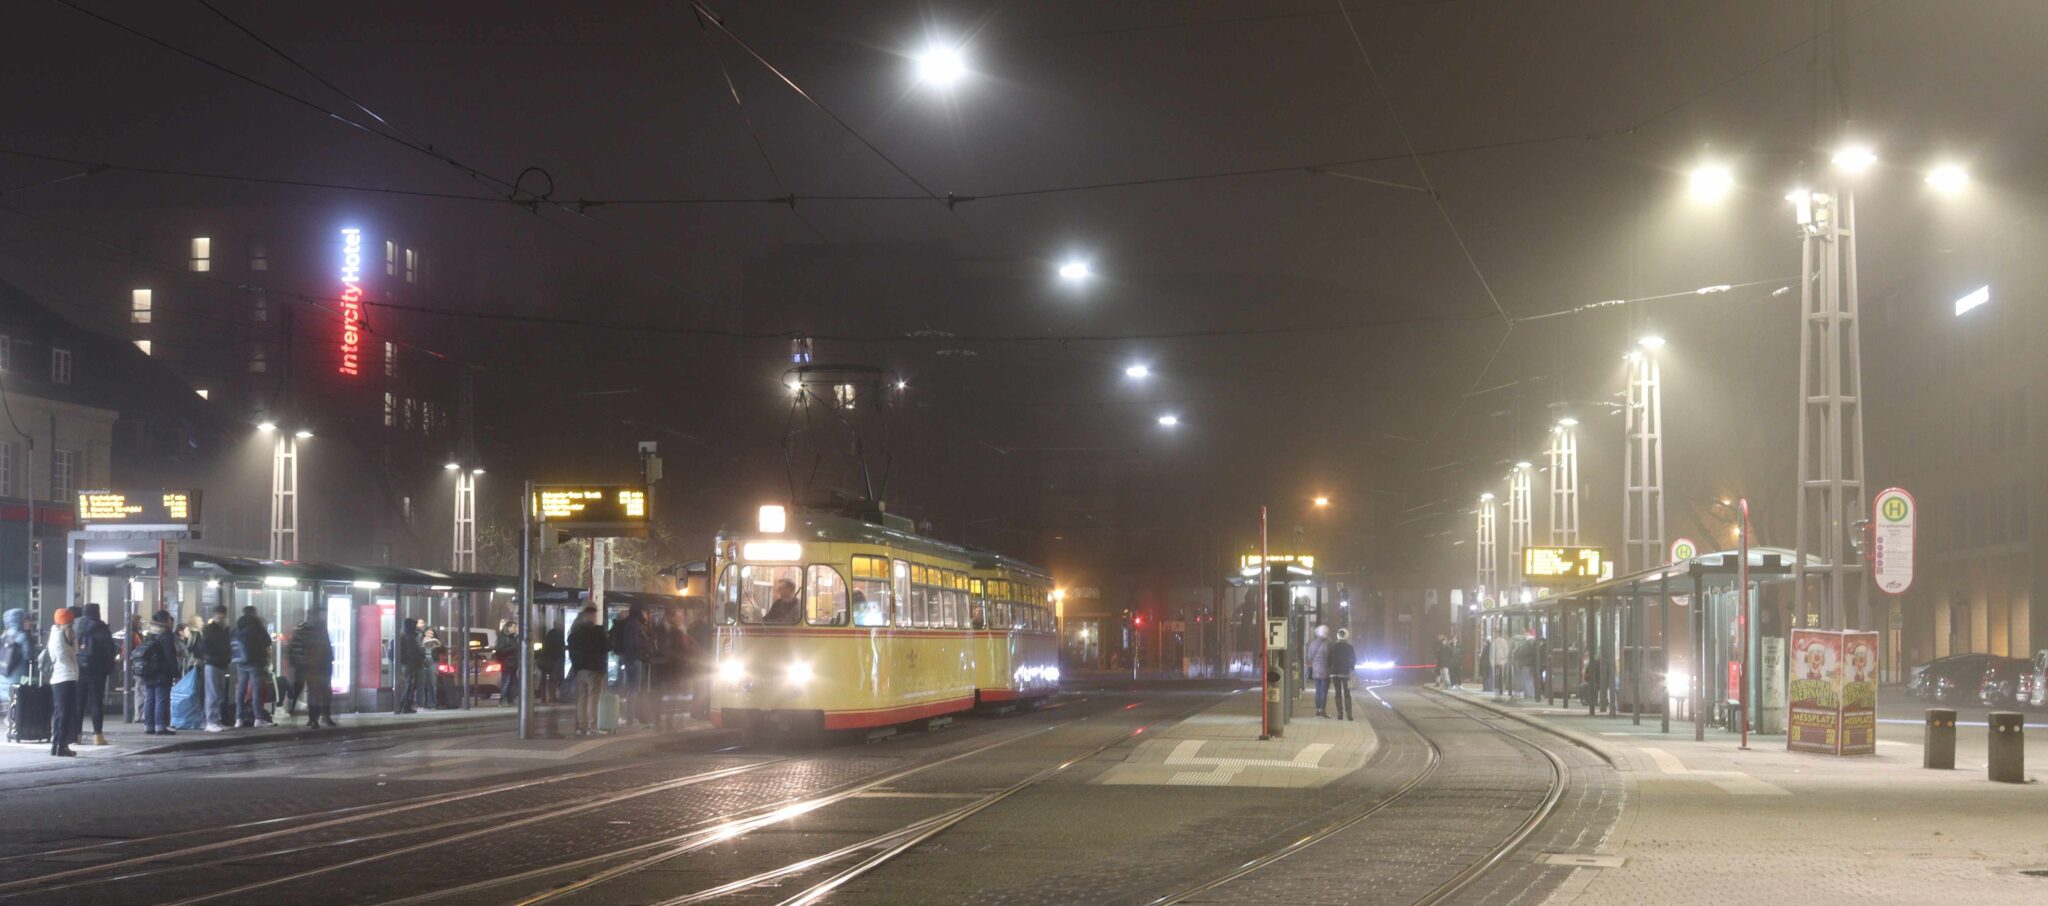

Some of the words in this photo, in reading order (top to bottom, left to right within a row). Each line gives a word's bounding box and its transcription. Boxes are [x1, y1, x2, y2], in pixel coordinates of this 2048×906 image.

[1889, 503, 1901, 516] H
[1269, 622, 1282, 645] F
[1793, 713, 1836, 725] MESSPLATZ
